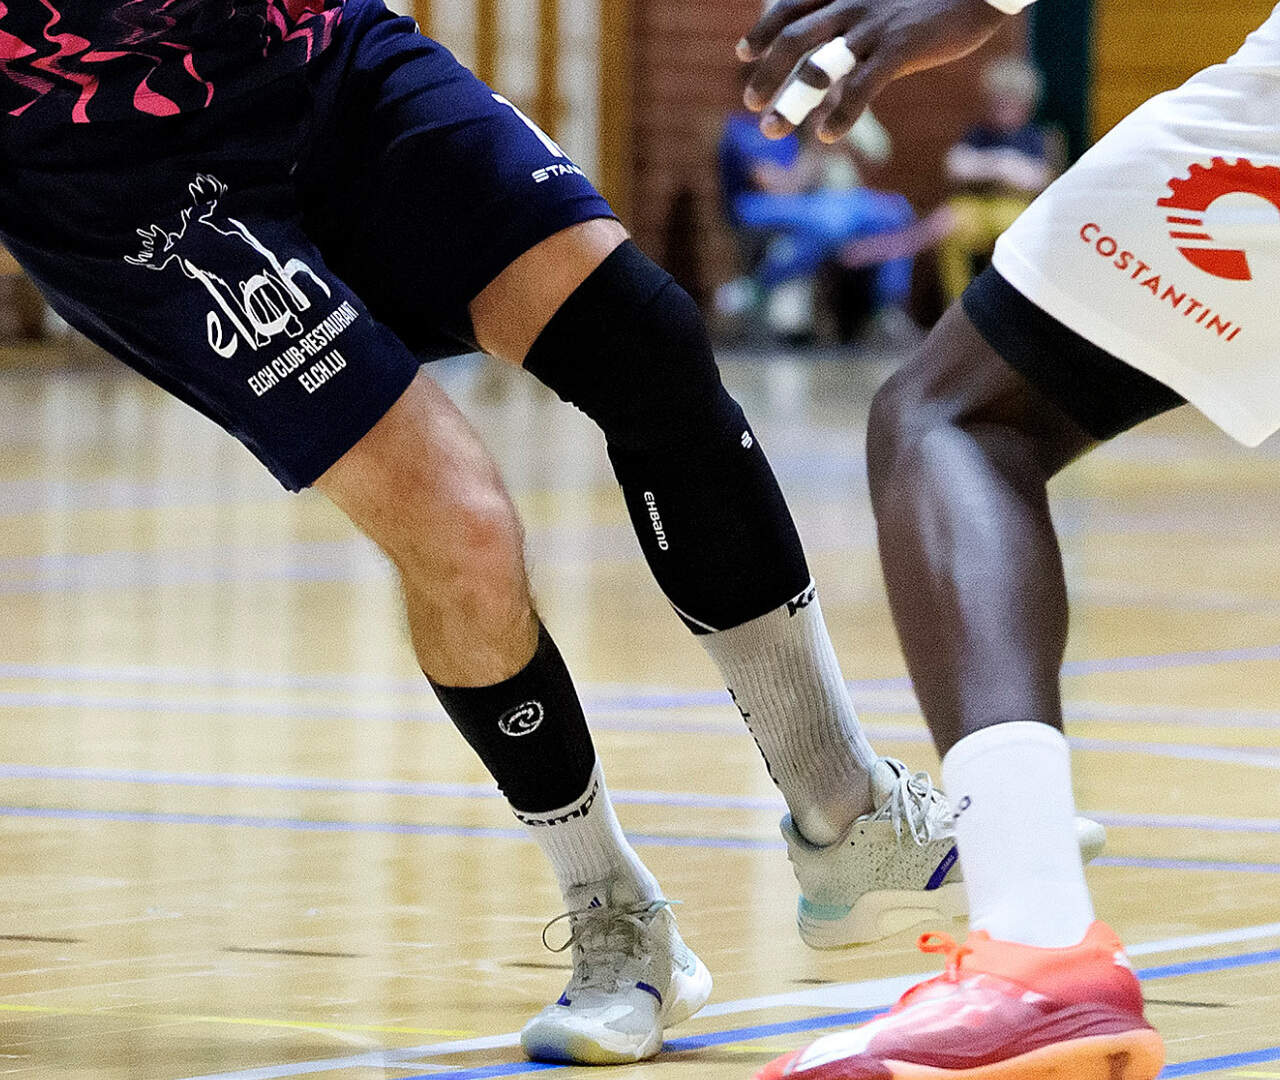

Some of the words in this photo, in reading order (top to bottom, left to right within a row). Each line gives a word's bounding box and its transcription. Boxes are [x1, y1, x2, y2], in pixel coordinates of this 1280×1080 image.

[1079, 222, 1242, 342] COSTANTINI
[247, 365, 280, 398] ELCH
[271, 299, 360, 379] CLUB-RESTAURANT
[297, 348, 348, 394] ELCH.LU
